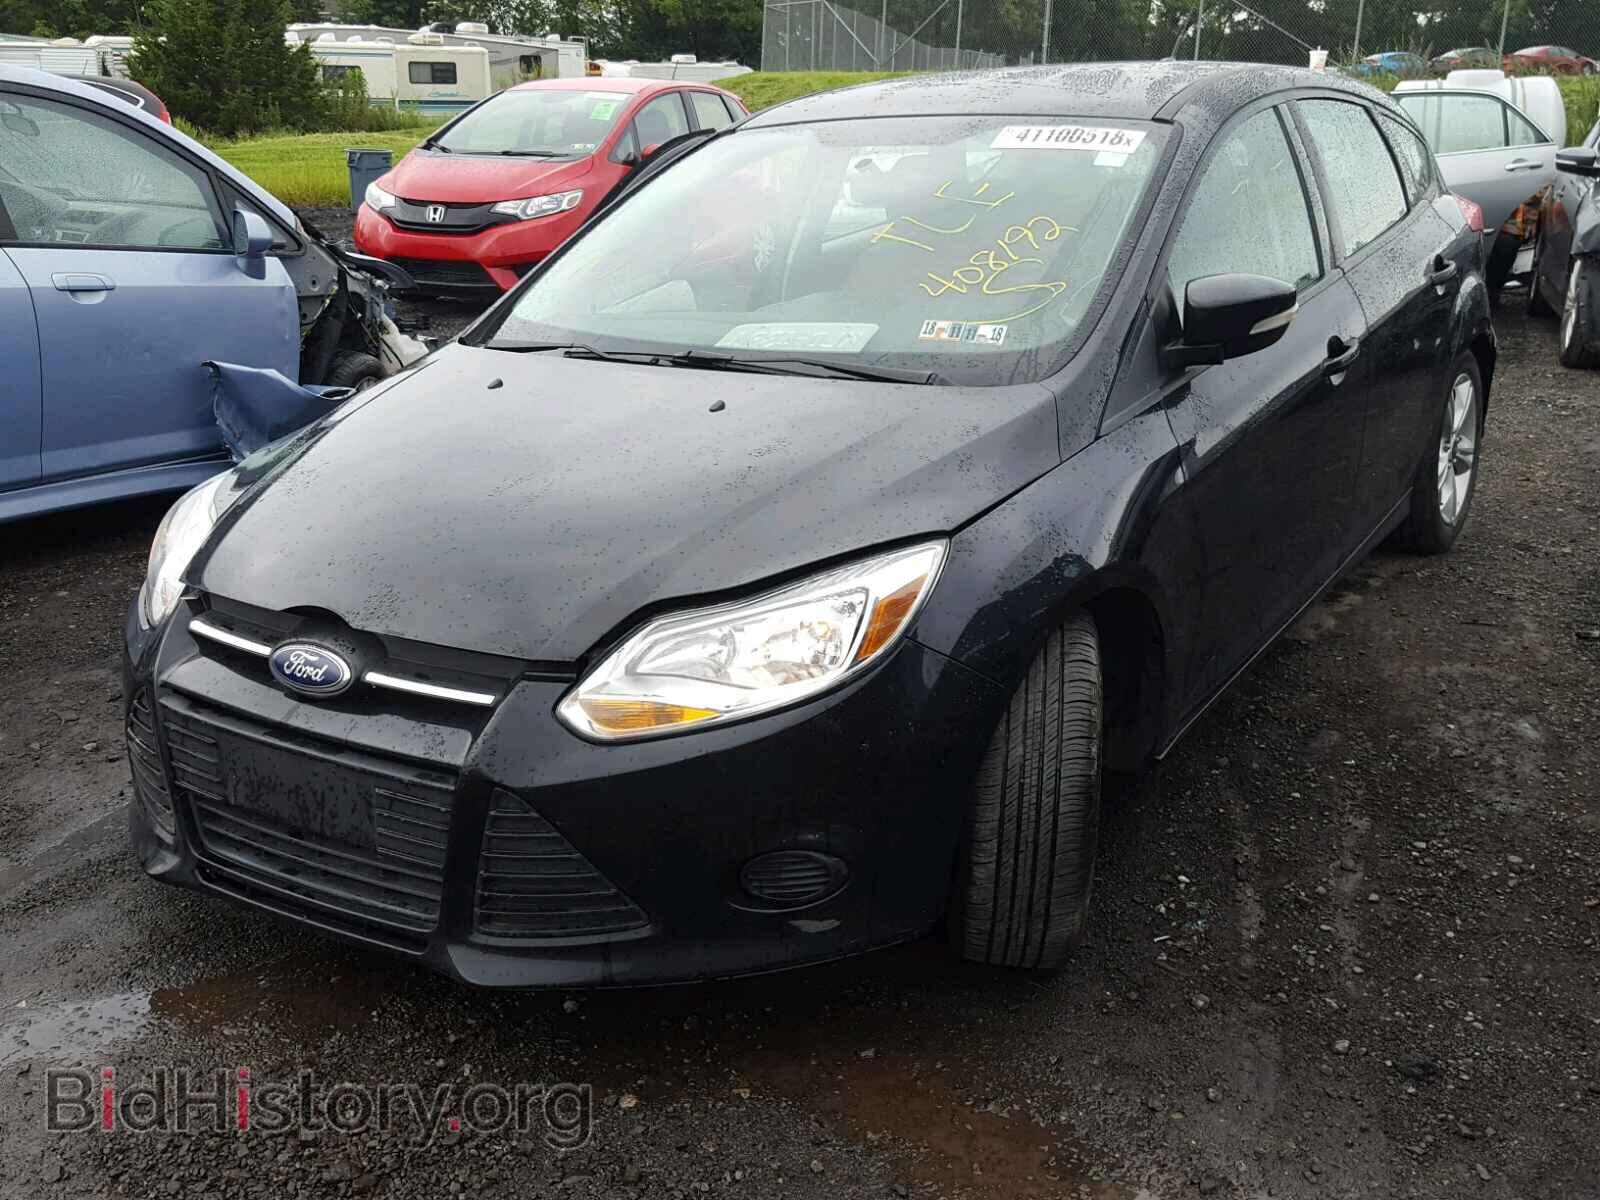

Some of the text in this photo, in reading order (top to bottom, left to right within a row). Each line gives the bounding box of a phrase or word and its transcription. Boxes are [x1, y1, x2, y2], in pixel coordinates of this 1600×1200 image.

[918, 215, 1080, 297] 408192
[922, 321, 937, 336] 18
[990, 327, 1004, 342] 18
[283, 650, 329, 682] Ford
